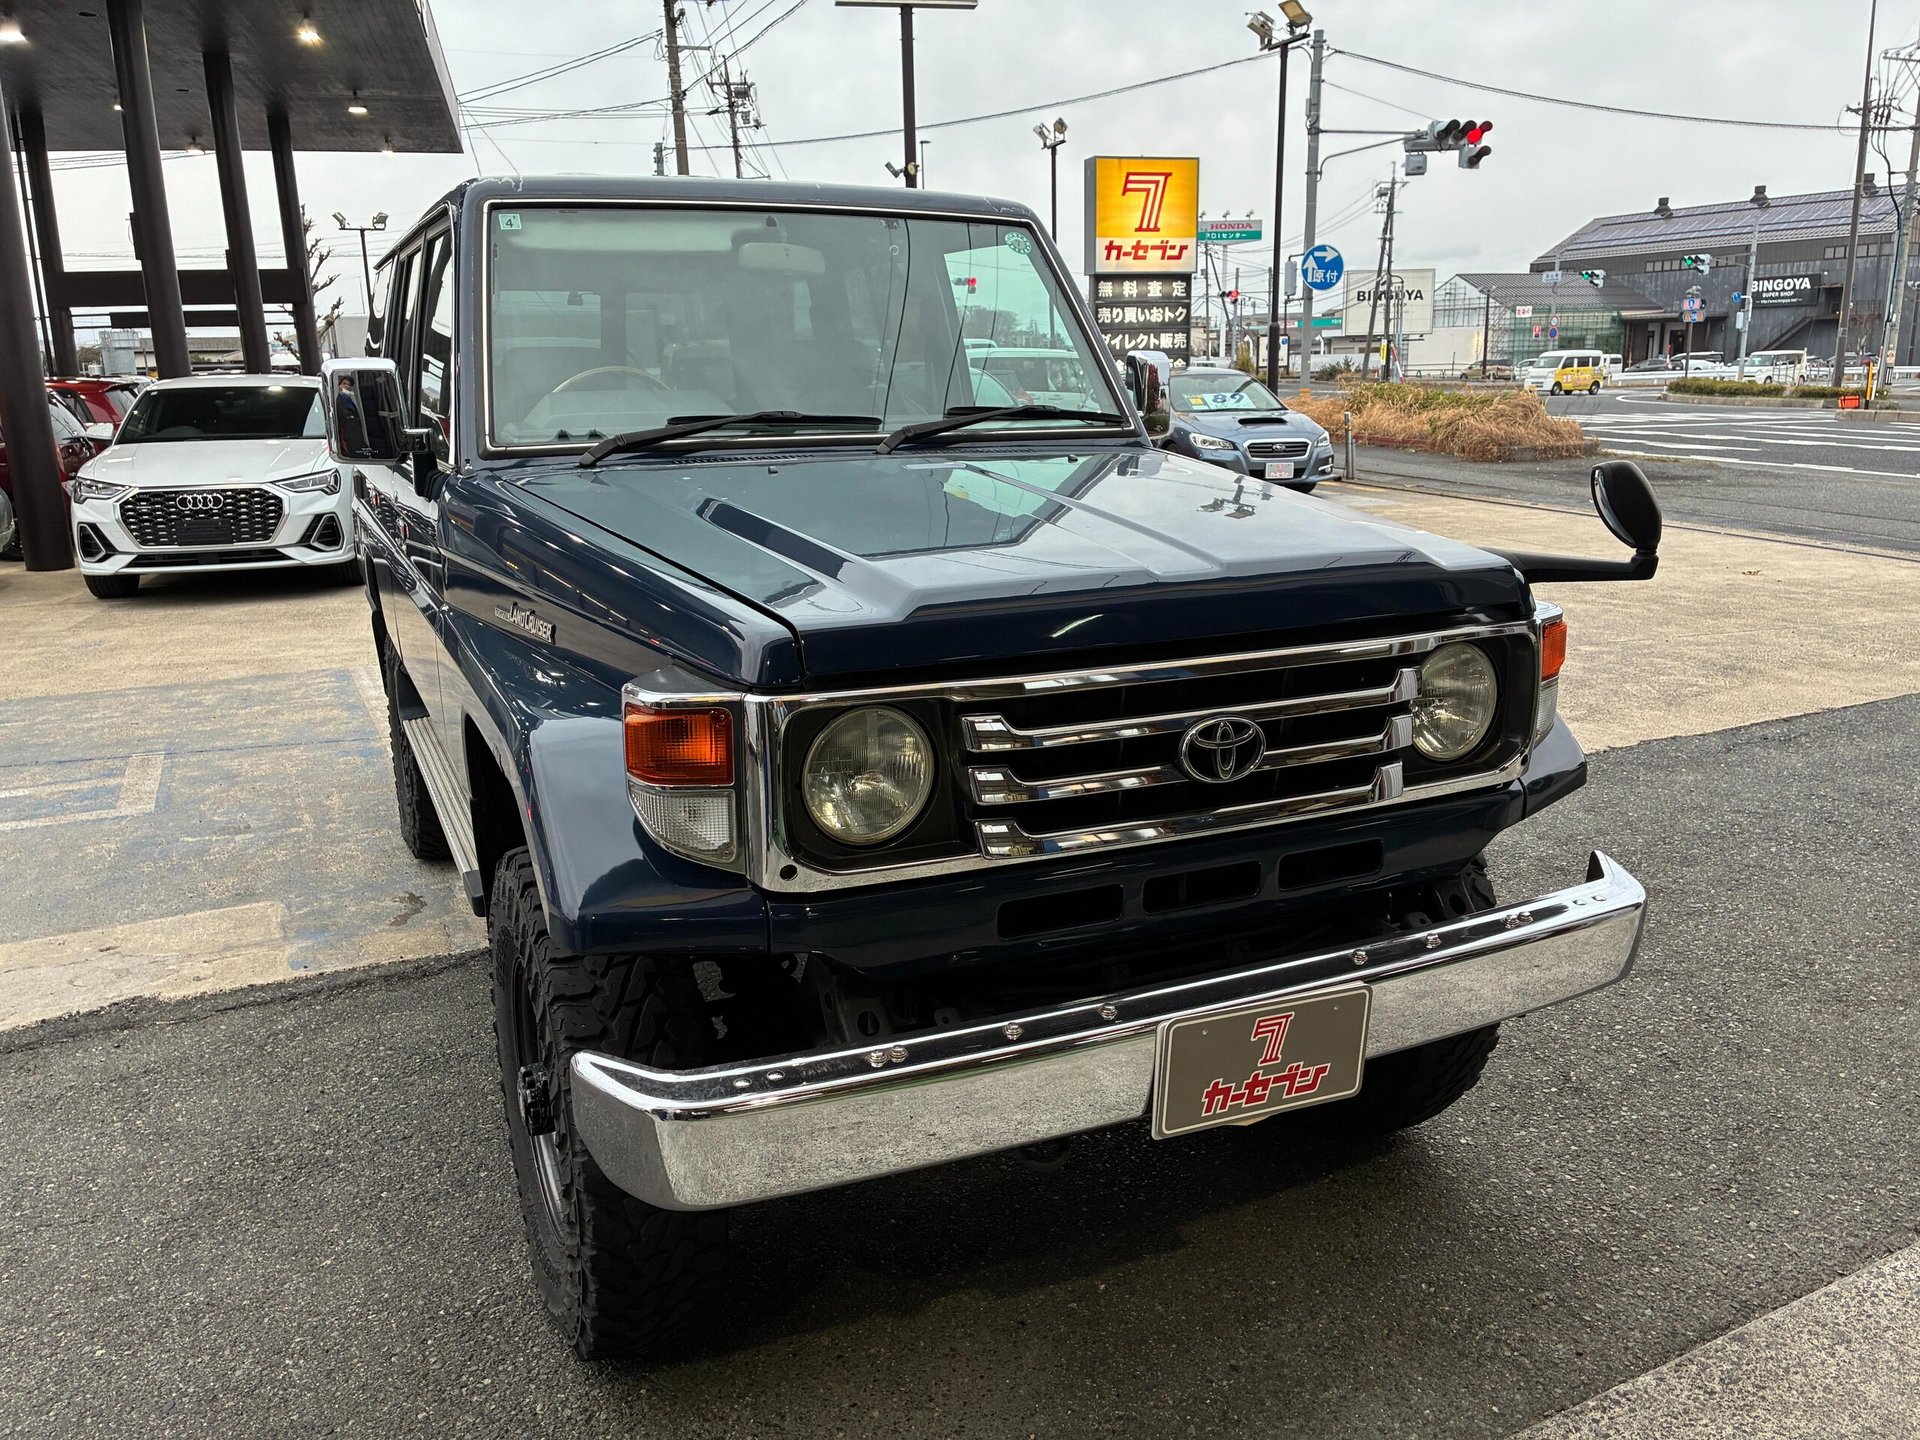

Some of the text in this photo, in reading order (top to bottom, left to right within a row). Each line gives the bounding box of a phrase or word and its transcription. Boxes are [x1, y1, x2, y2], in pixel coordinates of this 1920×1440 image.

[1210, 222, 1253, 230] HONDA
[1104, 239, 1189, 261] カーセブン
[1312, 269, 1338, 283] 原付
[1752, 277, 1812, 292] BINGOYA
[1097, 280, 1187, 298] 無料査定
[1097, 306, 1188, 324] 売り買いおトク
[1201, 1061, 1331, 1117] カーセブン
